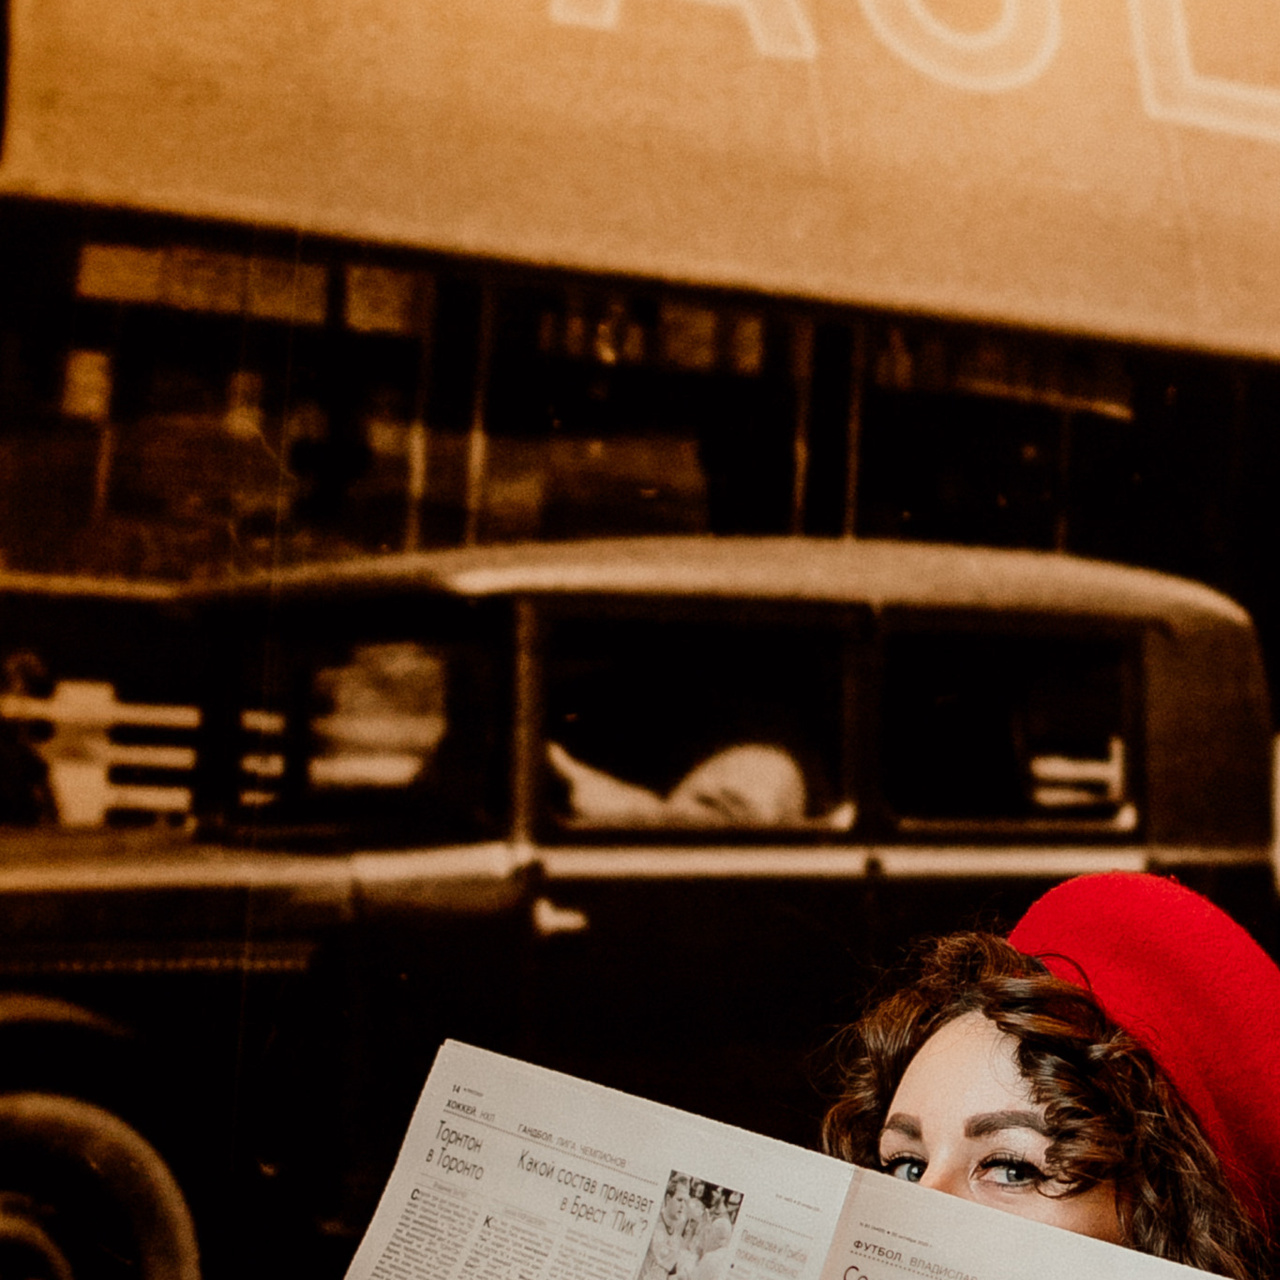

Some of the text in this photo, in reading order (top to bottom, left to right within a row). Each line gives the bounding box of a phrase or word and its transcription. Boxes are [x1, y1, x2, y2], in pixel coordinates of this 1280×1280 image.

[451, 1083, 461, 1094] 14
[433, 1120, 486, 1154] Торнтон
[555, 1135, 577, 1151] ЛИГА
[577, 1143, 628, 1168] ЧЕМПИОНОВ
[424, 1147, 487, 1181] в Торонто
[515, 1149, 656, 1214] Какой состав привезет
[558, 1195, 569, 1212] в
[568, 1194, 608, 1226] Брест
